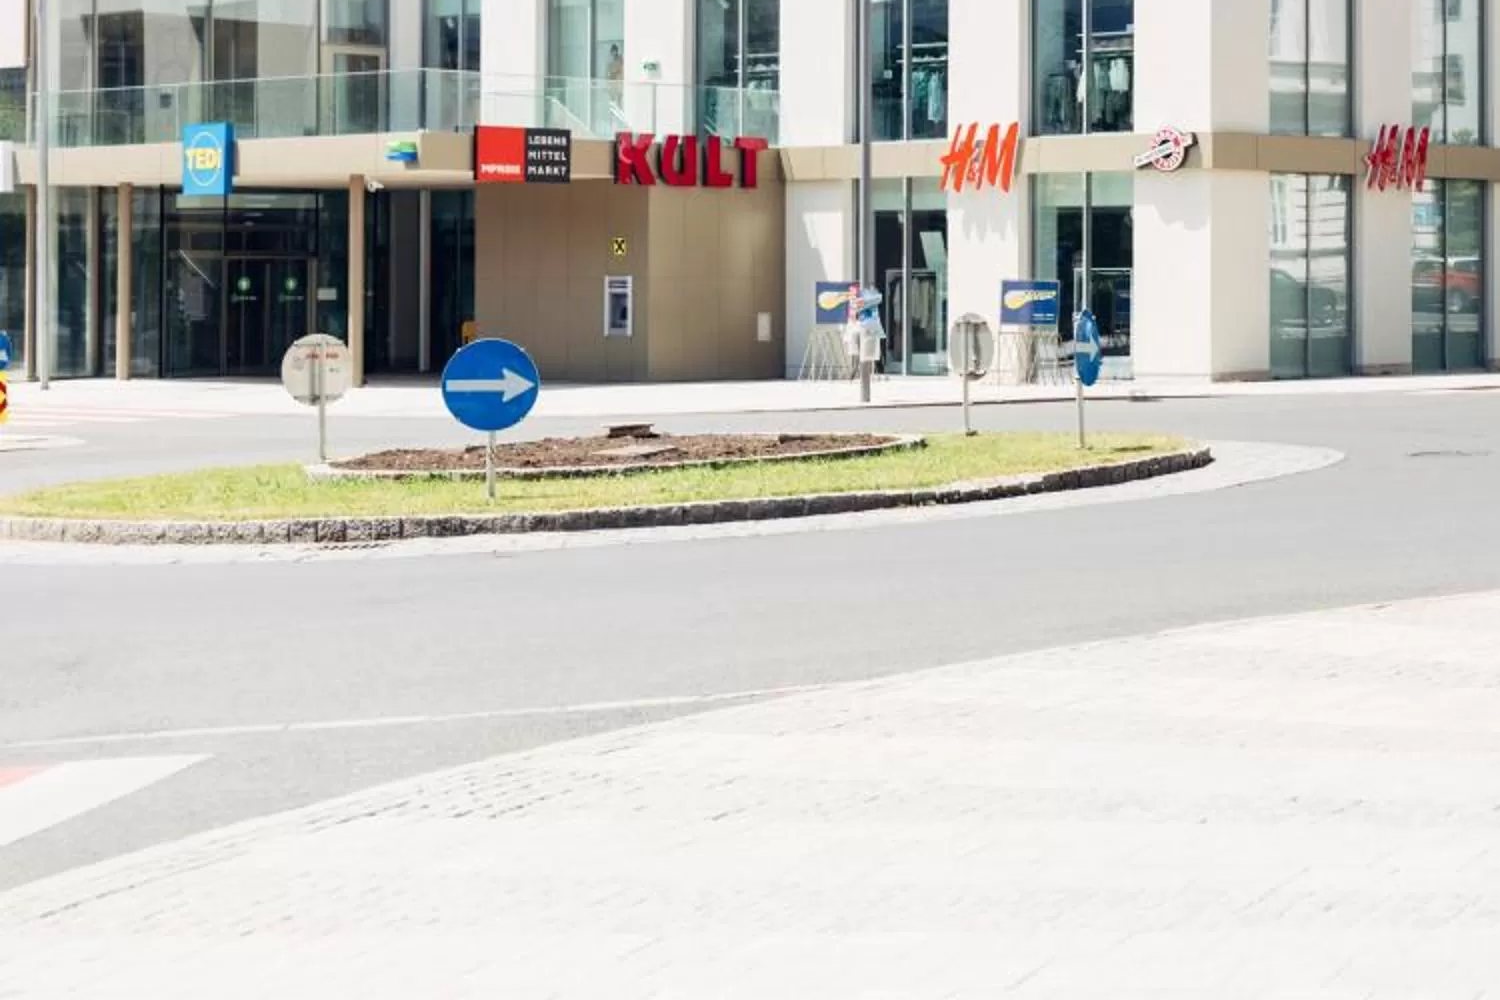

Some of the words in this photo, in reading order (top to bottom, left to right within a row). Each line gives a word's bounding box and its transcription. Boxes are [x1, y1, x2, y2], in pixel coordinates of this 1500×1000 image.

[528, 150, 567, 161] MITTEL
[528, 165, 567, 176] MARKT
[613, 132, 769, 188] KULT
[940, 121, 1018, 193] H&M
[1364, 123, 1430, 193] H&M
